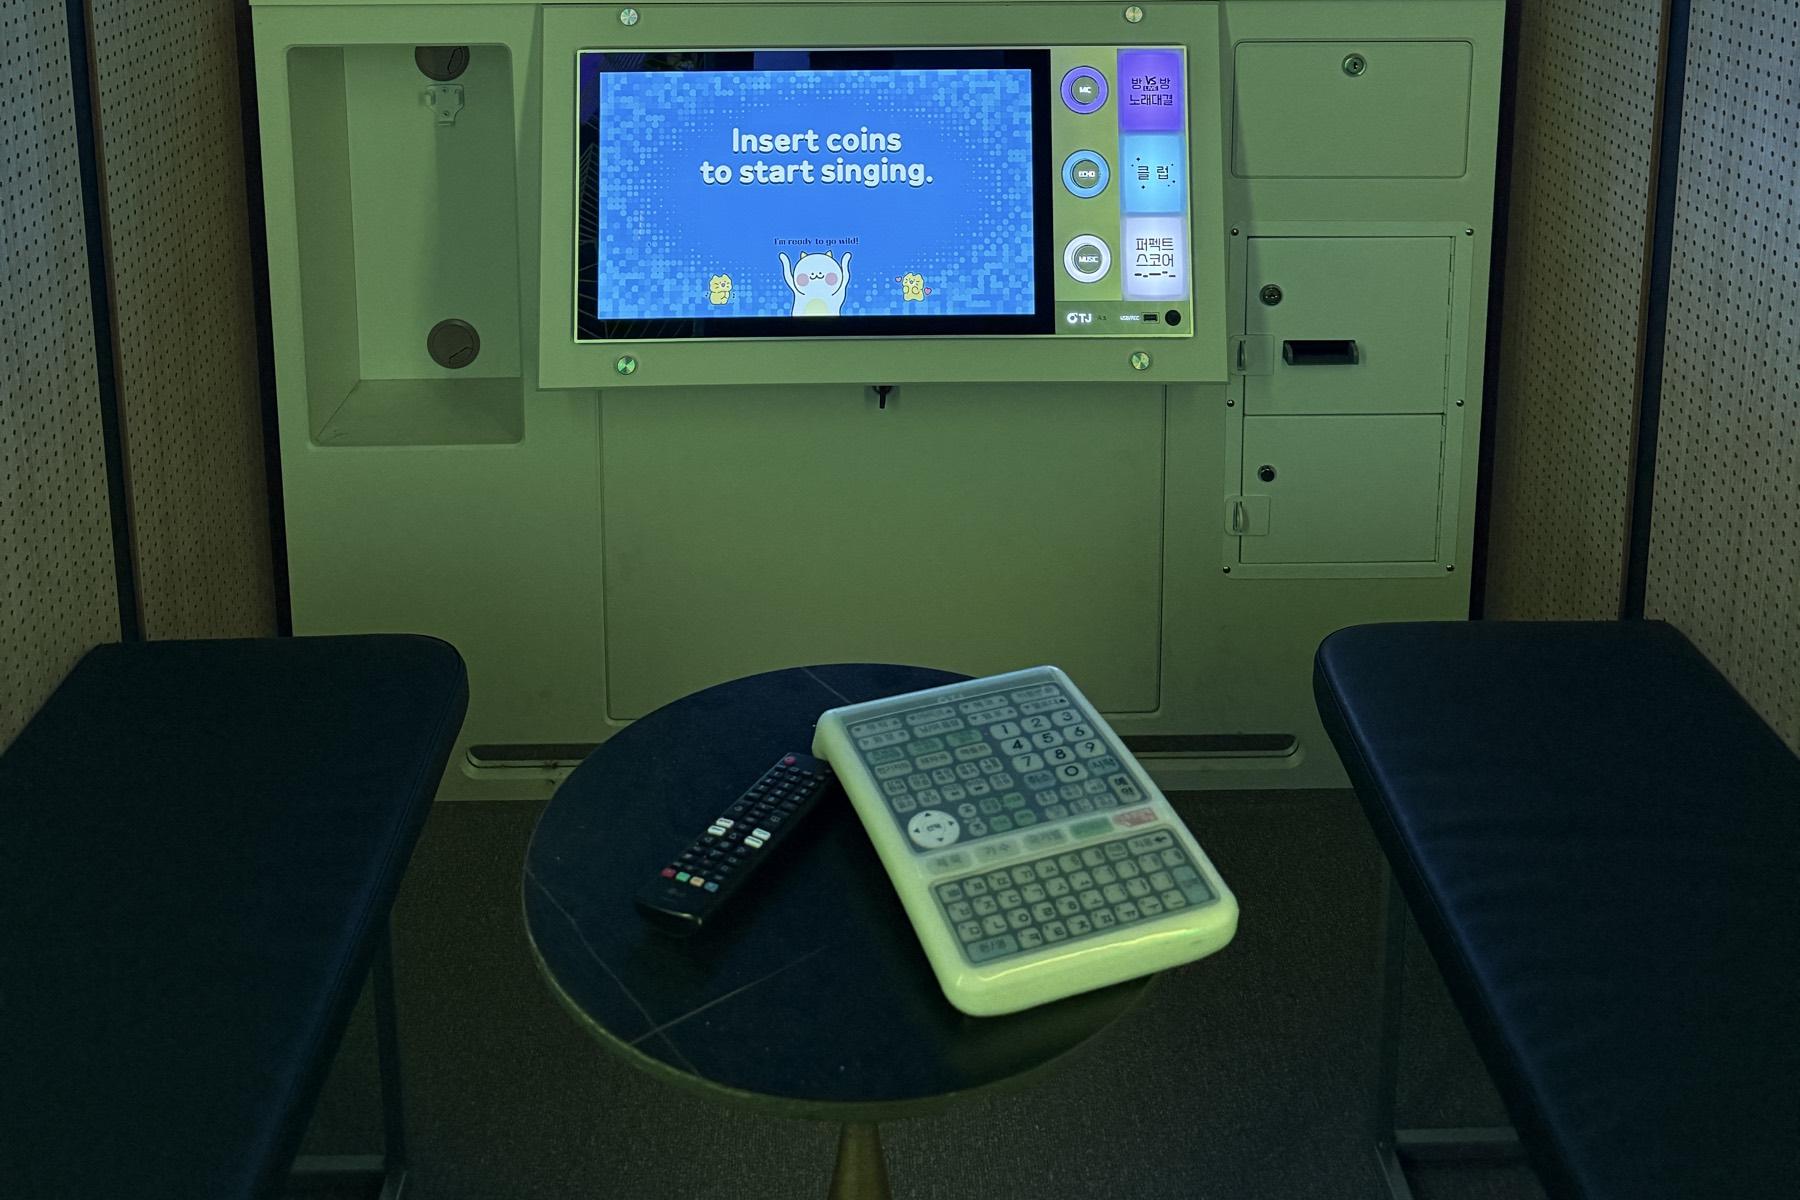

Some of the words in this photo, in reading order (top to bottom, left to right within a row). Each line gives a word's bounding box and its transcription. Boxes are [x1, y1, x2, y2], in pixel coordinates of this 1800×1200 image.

[1131, 77, 1142, 90] 방
[1145, 75, 1157, 85] VS
[1160, 77, 1171, 90] 방
[1129, 94, 1173, 106] 노래대결
[732, 127, 820, 153] Insert
[826, 126, 902, 153] coins
[700, 160, 733, 185] to
[739, 160, 815, 184] start
[821, 156, 934, 188] singing.
[839, 237, 859, 245] wild!
[1136, 237, 1174, 251] 퍼펙트
[1136, 253, 1174, 267] 스코어
[1001, 724, 1009, 735] 1
[1031, 718, 1042, 728] 2
[1062, 711, 1073, 721] 3
[1012, 739, 1023, 750] 4
[1042, 733, 1054, 743] 5
[1074, 727, 1085, 737] 6
[1022, 756, 1031, 767] 7
[1055, 749, 1066, 760] 8
[1085, 742, 1095, 753] 9
